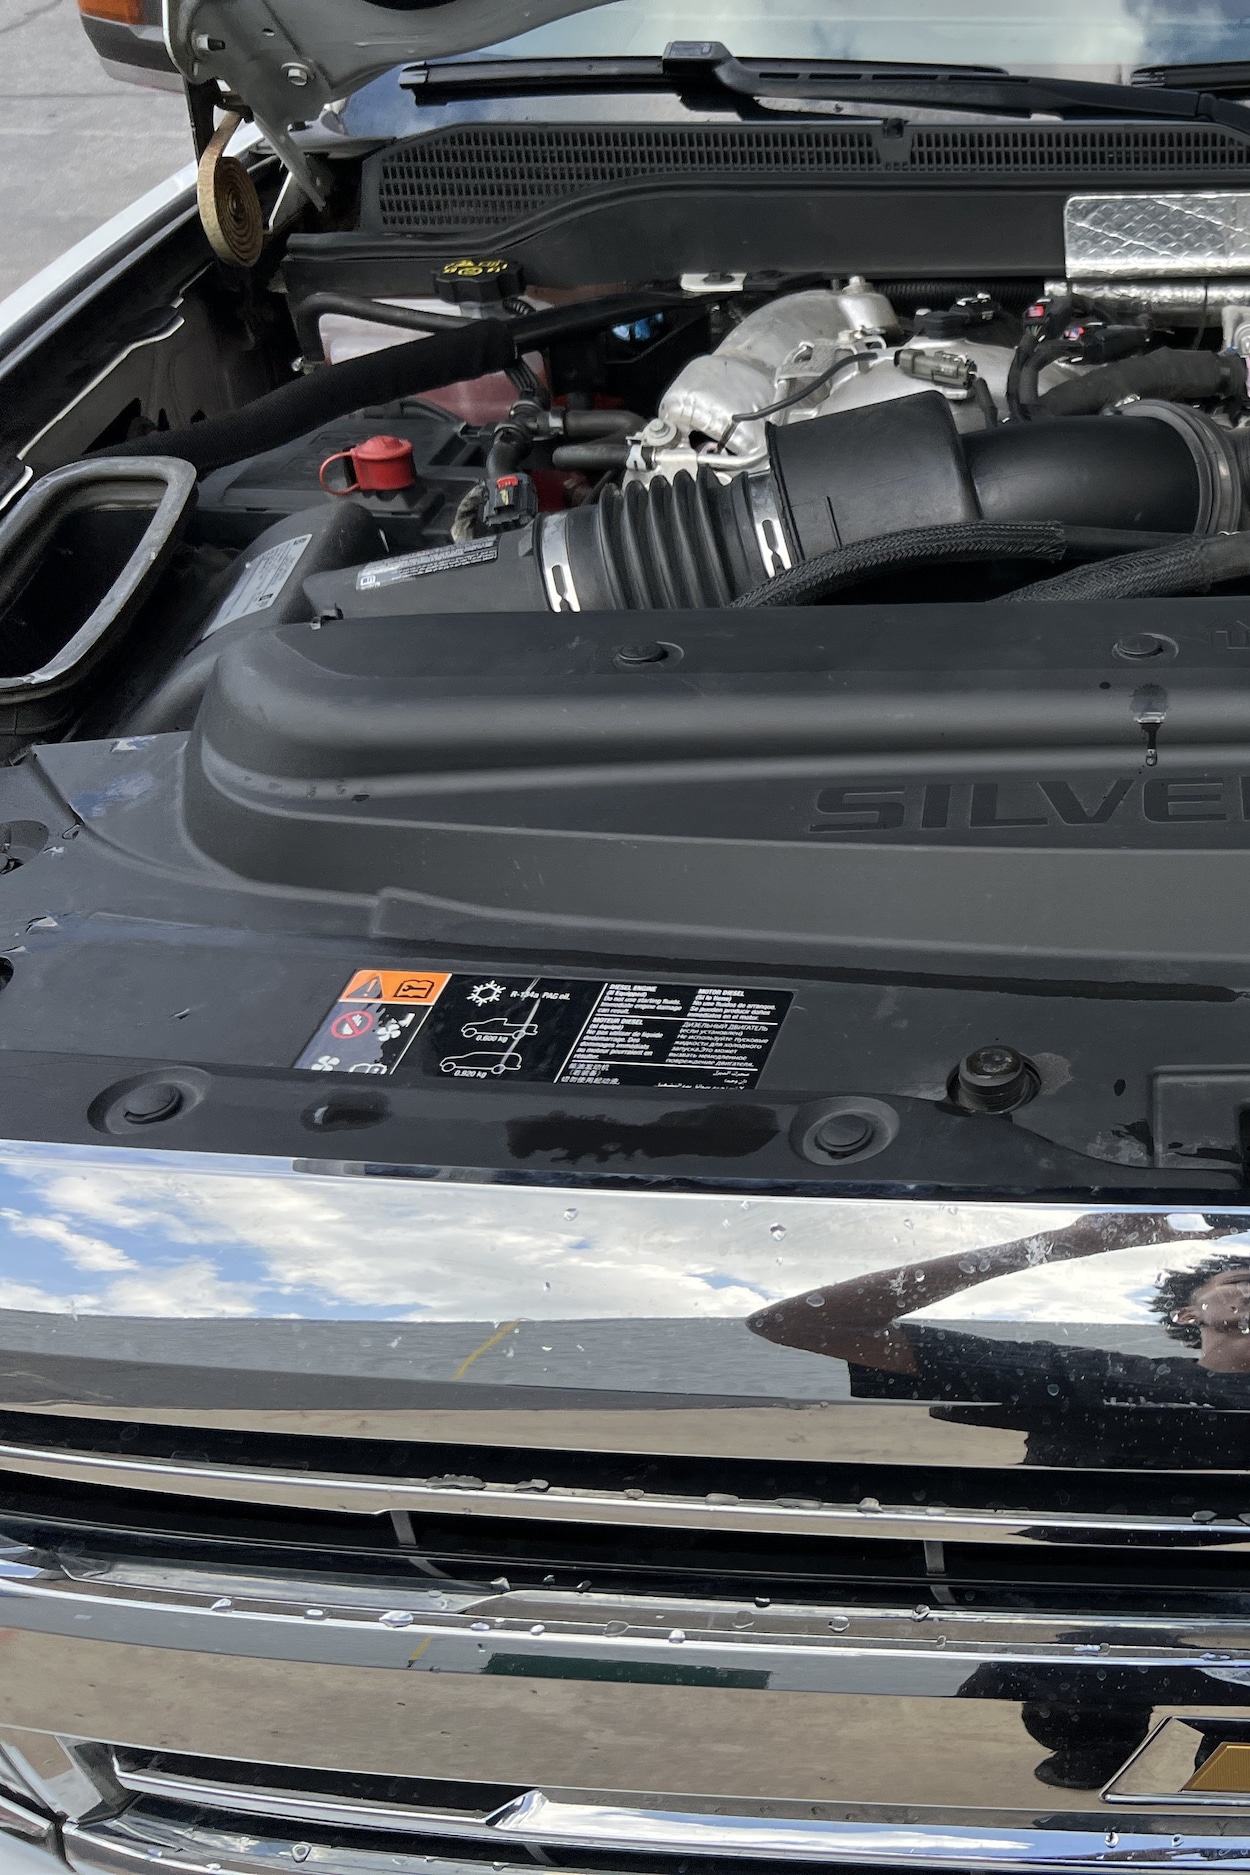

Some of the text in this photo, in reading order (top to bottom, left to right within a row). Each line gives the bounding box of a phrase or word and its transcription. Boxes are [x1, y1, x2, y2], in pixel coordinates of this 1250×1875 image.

[542, 992, 559, 1000] PAG
[498, 1036, 508, 1044] kg
[476, 1070, 487, 1078] kg
